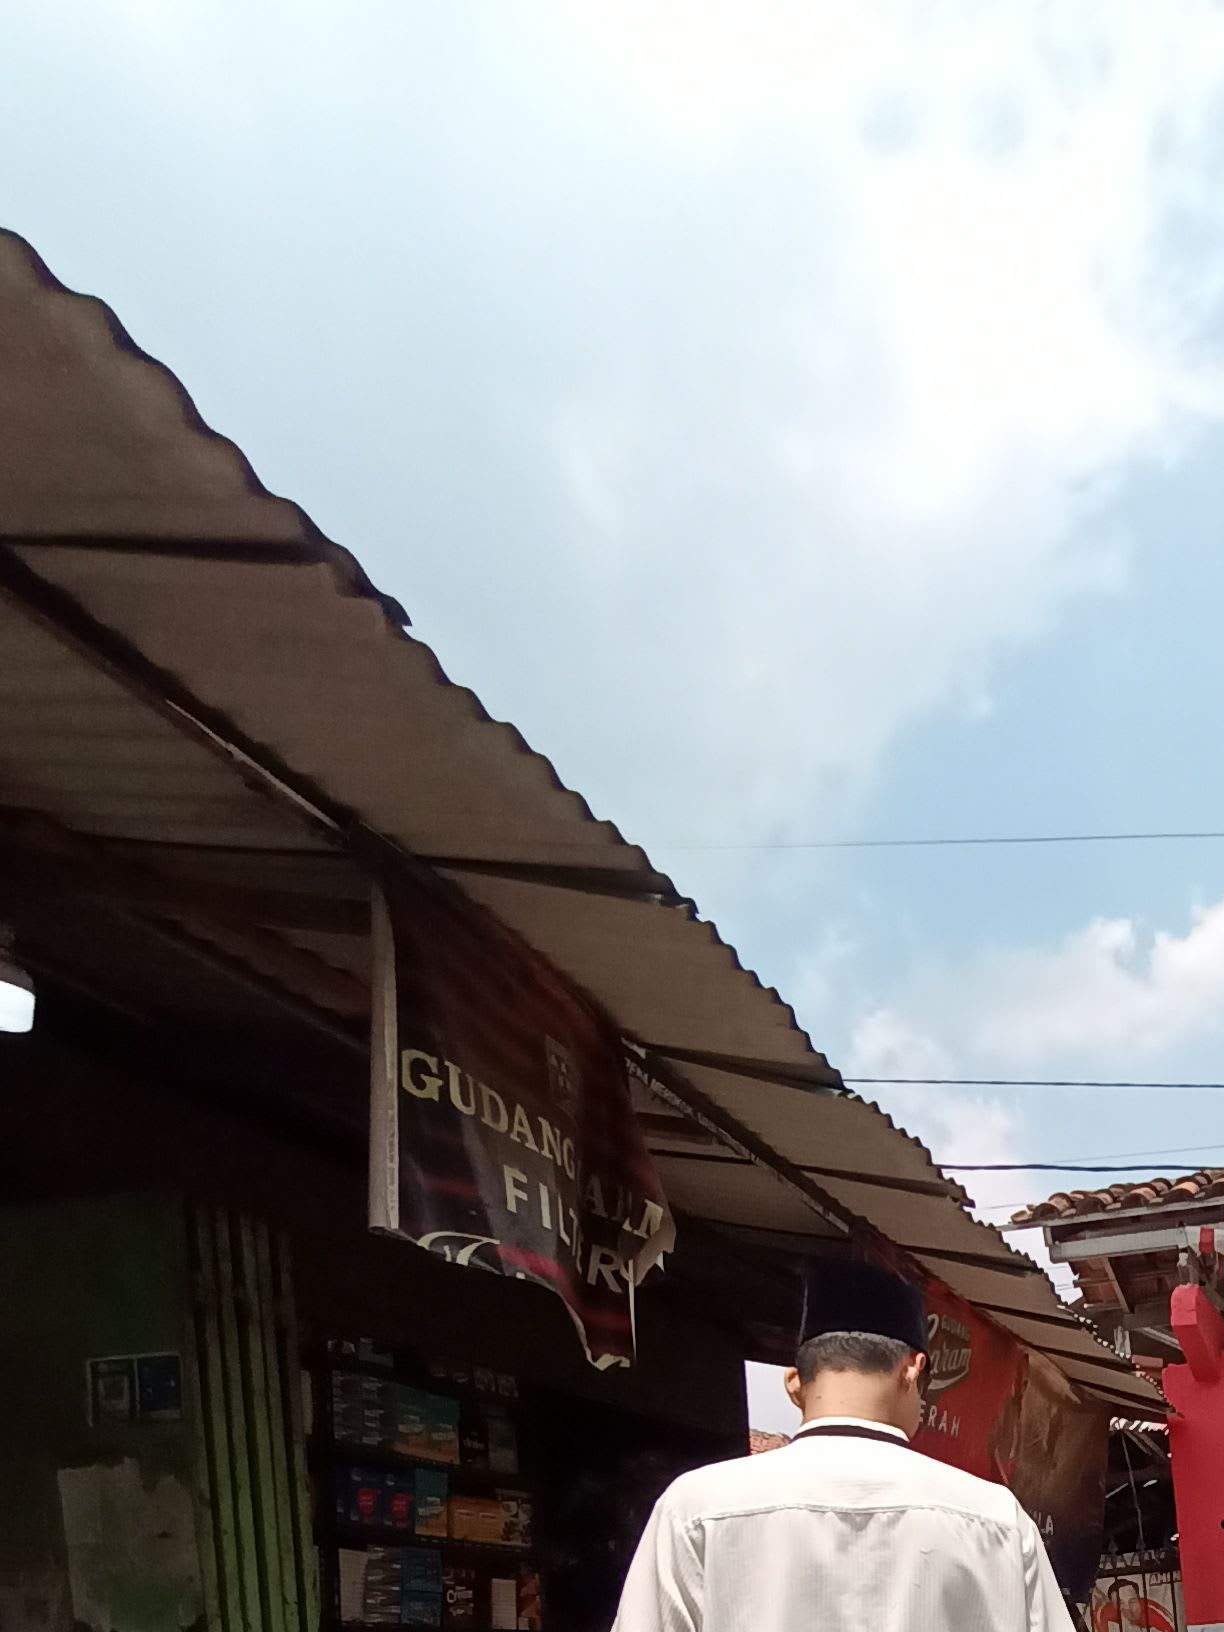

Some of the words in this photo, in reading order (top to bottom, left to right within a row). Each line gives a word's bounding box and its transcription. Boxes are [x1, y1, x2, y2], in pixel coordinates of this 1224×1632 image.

[401, 1048, 576, 1182] GUDANG
[503, 1163, 624, 1293] FILTR
[919, 1400, 961, 1438] ERAH
